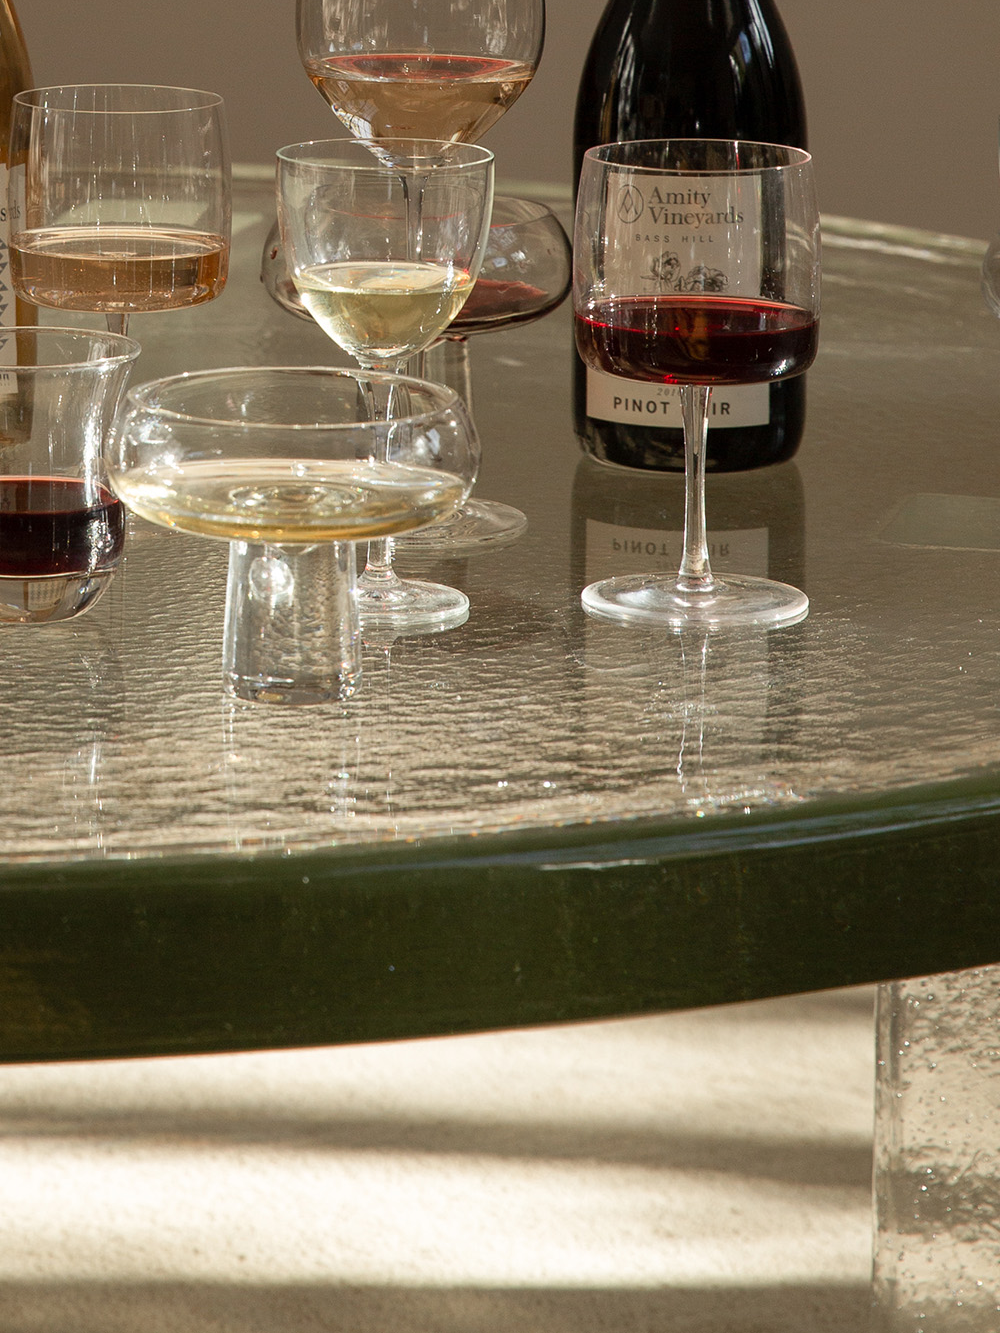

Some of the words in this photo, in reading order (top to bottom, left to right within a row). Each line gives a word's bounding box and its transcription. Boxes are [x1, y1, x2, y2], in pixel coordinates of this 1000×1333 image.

[648, 186, 711, 208] Amity
[648, 206, 744, 229] Vineyards
[681, 235, 714, 243] HILL
[613, 396, 671, 414] PINOT
